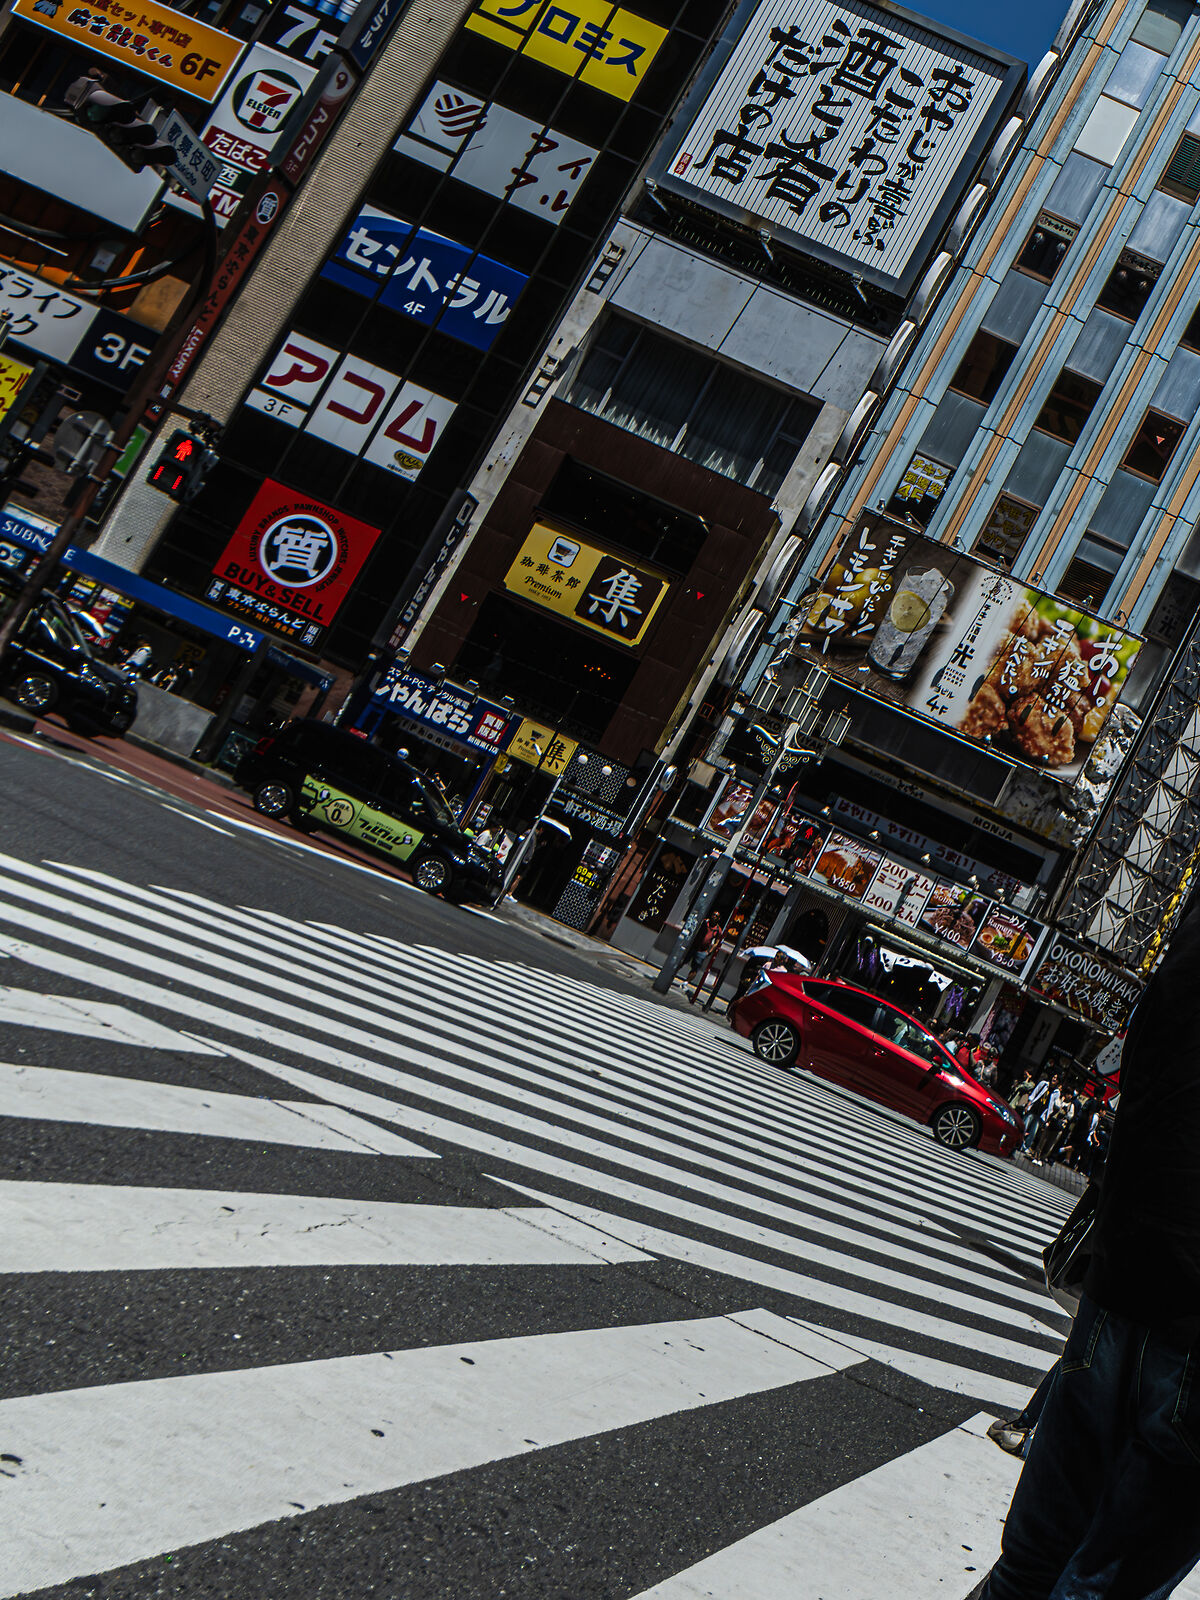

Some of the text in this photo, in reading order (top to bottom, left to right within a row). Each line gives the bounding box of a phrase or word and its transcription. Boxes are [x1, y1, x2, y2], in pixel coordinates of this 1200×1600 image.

[276, 5, 338, 60] 7F
[180, 52, 221, 81] 6F
[693, 25, 822, 186] だけの店
[754, 18, 906, 217] 酒と肴
[167, 122, 216, 181] 歌舞伎町
[209, 132, 267, 169] たばこ
[819, 67, 925, 229] こだわりの
[852, 65, 975, 251] おやじが喜ぶ
[345, 227, 511, 324] セントラル
[403, 300, 425, 315] 4F
[94, 331, 151, 370] 3F
[171, 327, 203, 378] LUXURY
[264, 398, 292, 417] 3F
[266, 344, 437, 454] アコム
[912, 458, 950, 480] チキン
[294, 503, 339, 525] PAWNSHOP
[270, 525, 329, 578] 質
[520, 556, 580, 589] 珈琲茶館
[278, 588, 324, 620] SELL
[524, 575, 562, 599] Premium
[588, 568, 643, 628] 集
[821, 527, 876, 654] レモンサワー
[952, 643, 977, 670] 光
[1031, 618, 1076, 680] チキンが
[926, 695, 949, 716] 4F
[1043, 660, 1089, 718] 猛烈に
[547, 739, 568, 769] 集
[551, 798, 624, 838] 一軒め酒場
[972, 816, 1014, 841] MONJA
[992, 907, 1028, 932] らーめん
[1046, 965, 1124, 1019] お好み焼き
[1050, 944, 1142, 1003] OKONOMIYAKI
